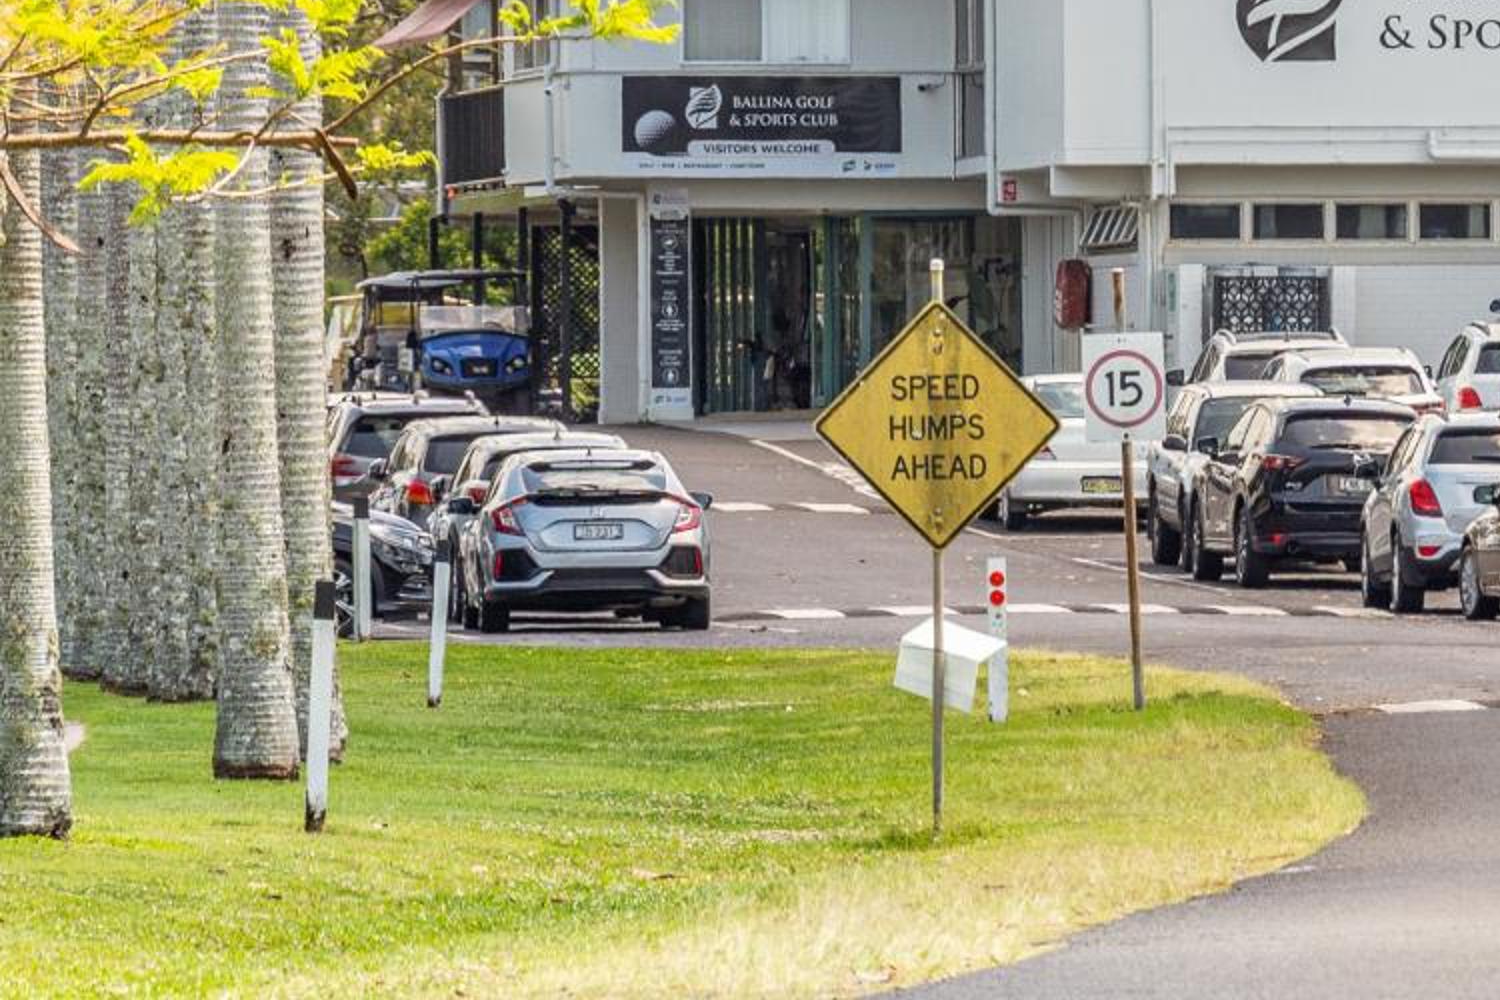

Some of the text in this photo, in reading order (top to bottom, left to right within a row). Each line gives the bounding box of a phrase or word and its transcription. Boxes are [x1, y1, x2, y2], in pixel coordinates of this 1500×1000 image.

[1379, 15, 1411, 50] &
[733, 95, 835, 109] BALLINA GOLF
[729, 113, 839, 127] & SPORTS CLUB
[703, 143, 820, 153] VISITORS WELCOME
[891, 374, 980, 401] SPEED
[1105, 370, 1143, 407] 15
[889, 414, 985, 441] HUMPS
[891, 454, 987, 481] AHEAD
